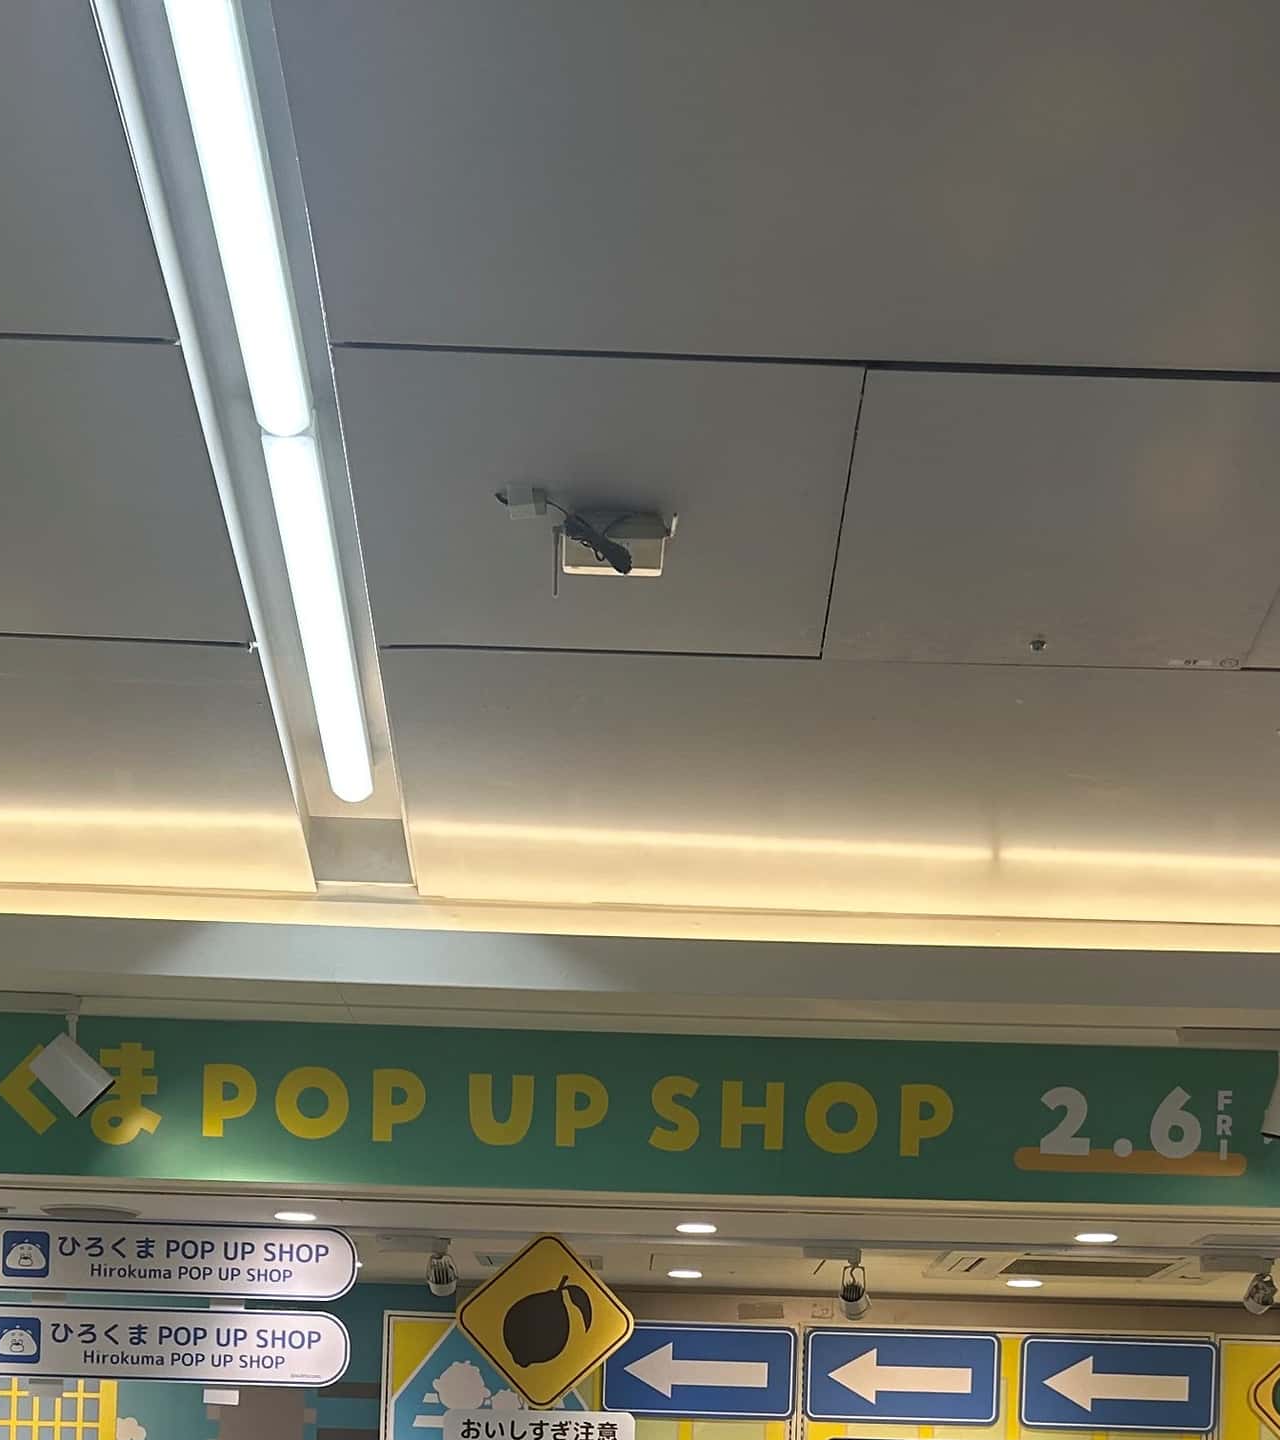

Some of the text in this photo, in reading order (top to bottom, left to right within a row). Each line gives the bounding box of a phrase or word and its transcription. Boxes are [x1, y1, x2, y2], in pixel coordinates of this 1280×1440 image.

[202, 1063, 426, 1143] POP
[469, 1073, 609, 1147] UP
[648, 1076, 953, 1157] SHOP
[1039, 1085, 1202, 1159] 2.6
[1216, 1090, 1233, 1161] FRI
[58, 1236, 329, 1263] ひろくま POP UP SHOP
[90, 1264, 292, 1283] Hirokuma POP UP SHOP
[51, 1322, 321, 1350] ひろくま POP UP SHOP
[83, 1350, 285, 1369] Hirokuma POP UP SHOP
